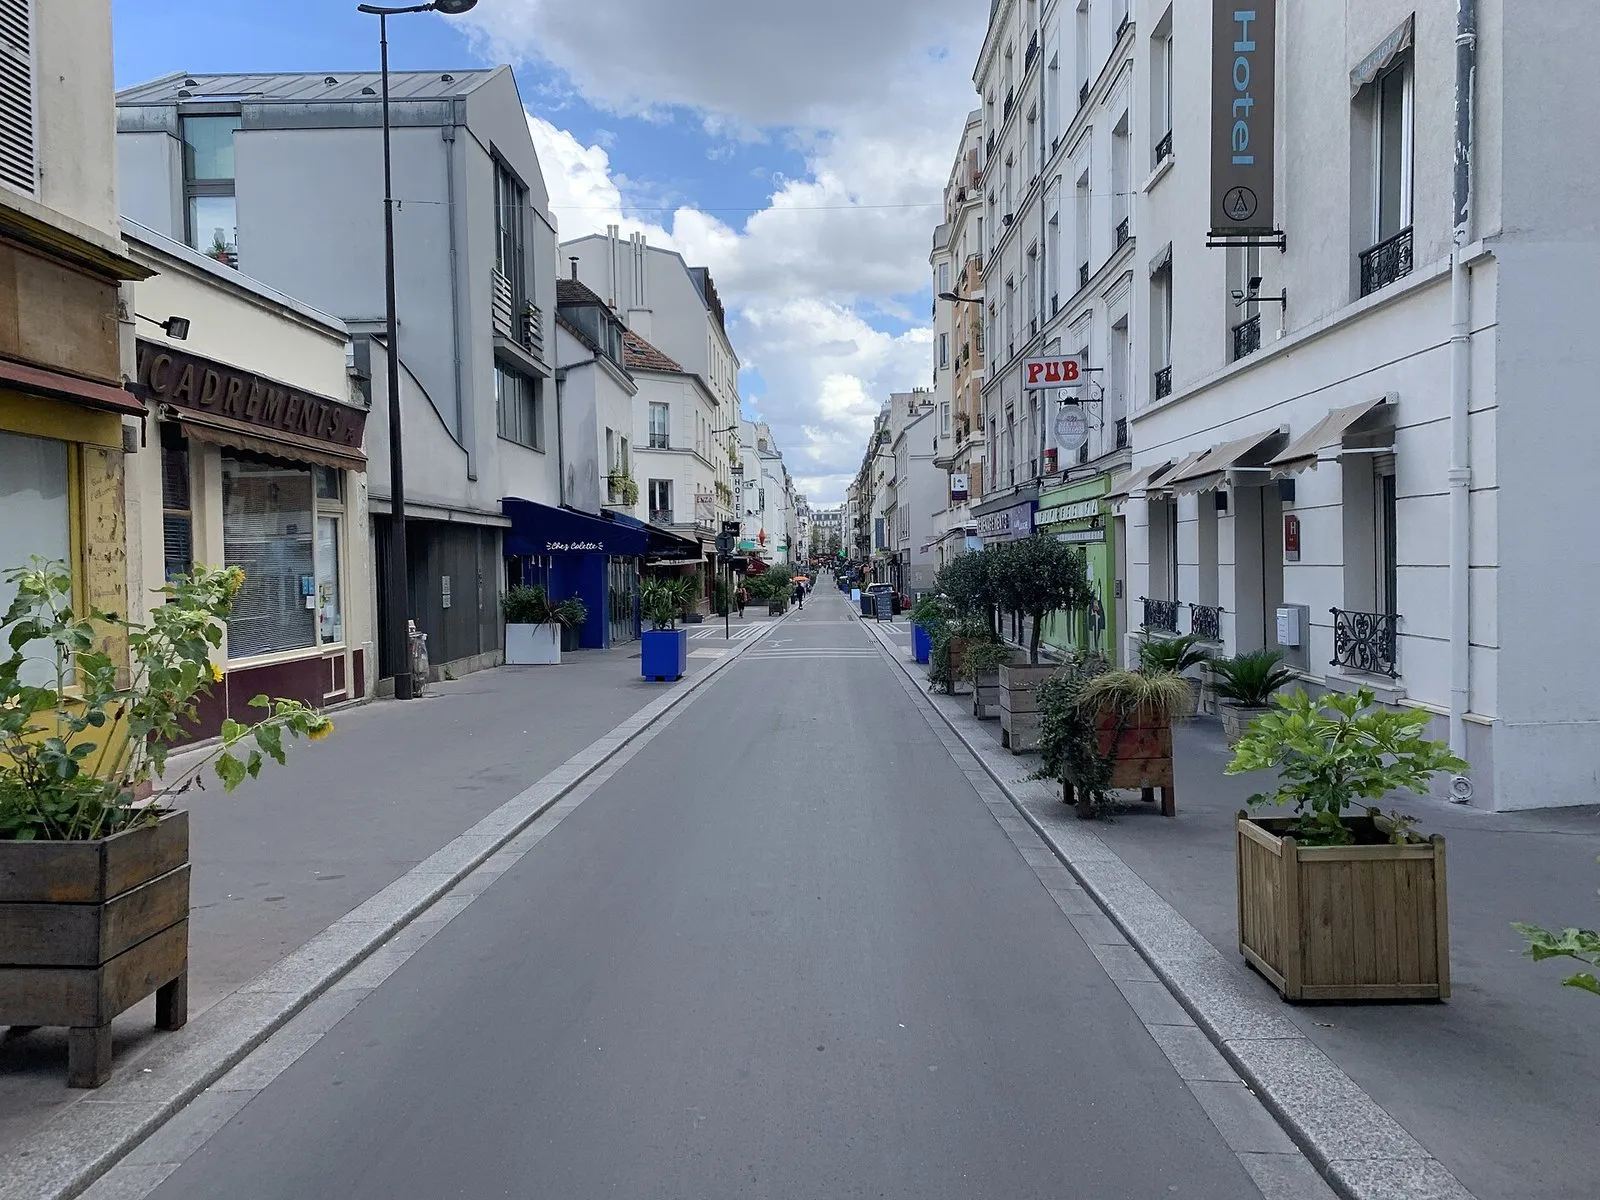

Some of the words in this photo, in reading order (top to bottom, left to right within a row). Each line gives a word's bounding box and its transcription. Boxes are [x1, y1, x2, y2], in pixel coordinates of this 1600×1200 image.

[1232, 10, 1256, 164] Hotel
[1027, 360, 1080, 384] PUB
[696, 496, 713, 504] ENZO
[1290, 521, 1297, 535] H
[551, 542, 569, 551] Chez
[570, 541, 598, 550] Colette
